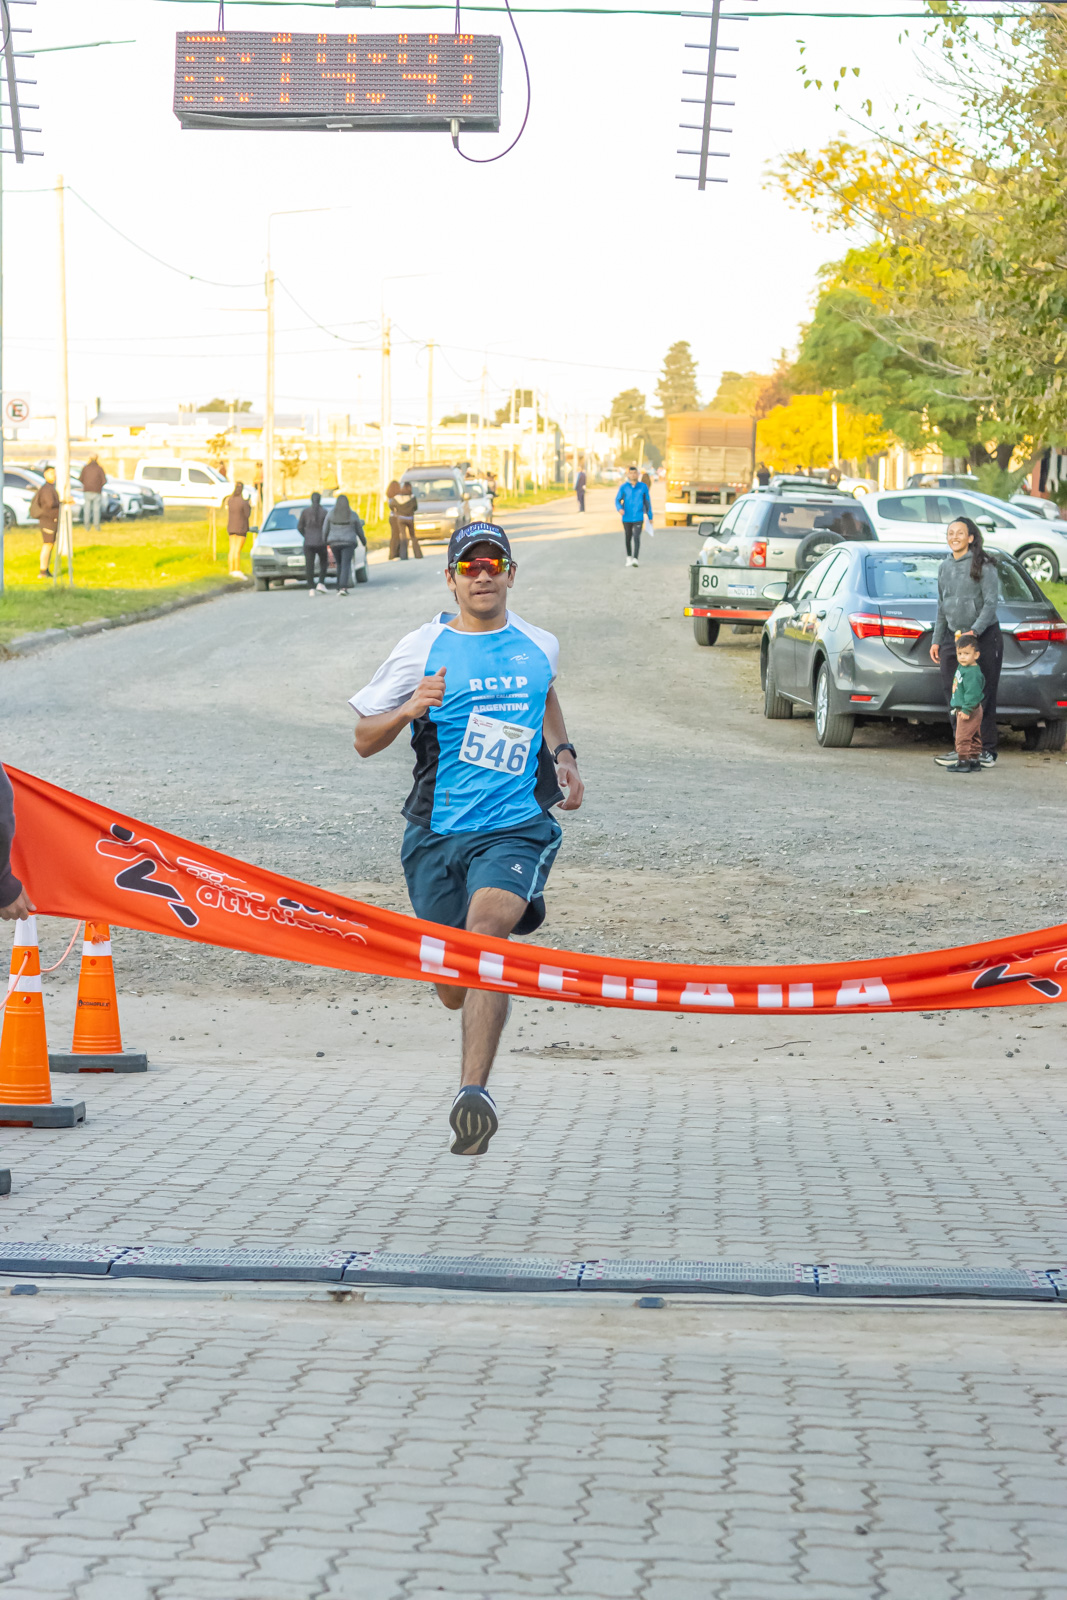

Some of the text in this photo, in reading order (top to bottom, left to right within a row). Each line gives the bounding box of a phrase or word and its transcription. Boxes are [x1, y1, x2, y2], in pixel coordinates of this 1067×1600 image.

[12, 404, 23, 417] E
[701, 574, 719, 588] 80
[469, 676, 528, 691] RCYP
[472, 702, 529, 713] ARGENTINA
[463, 731, 527, 772] 546
